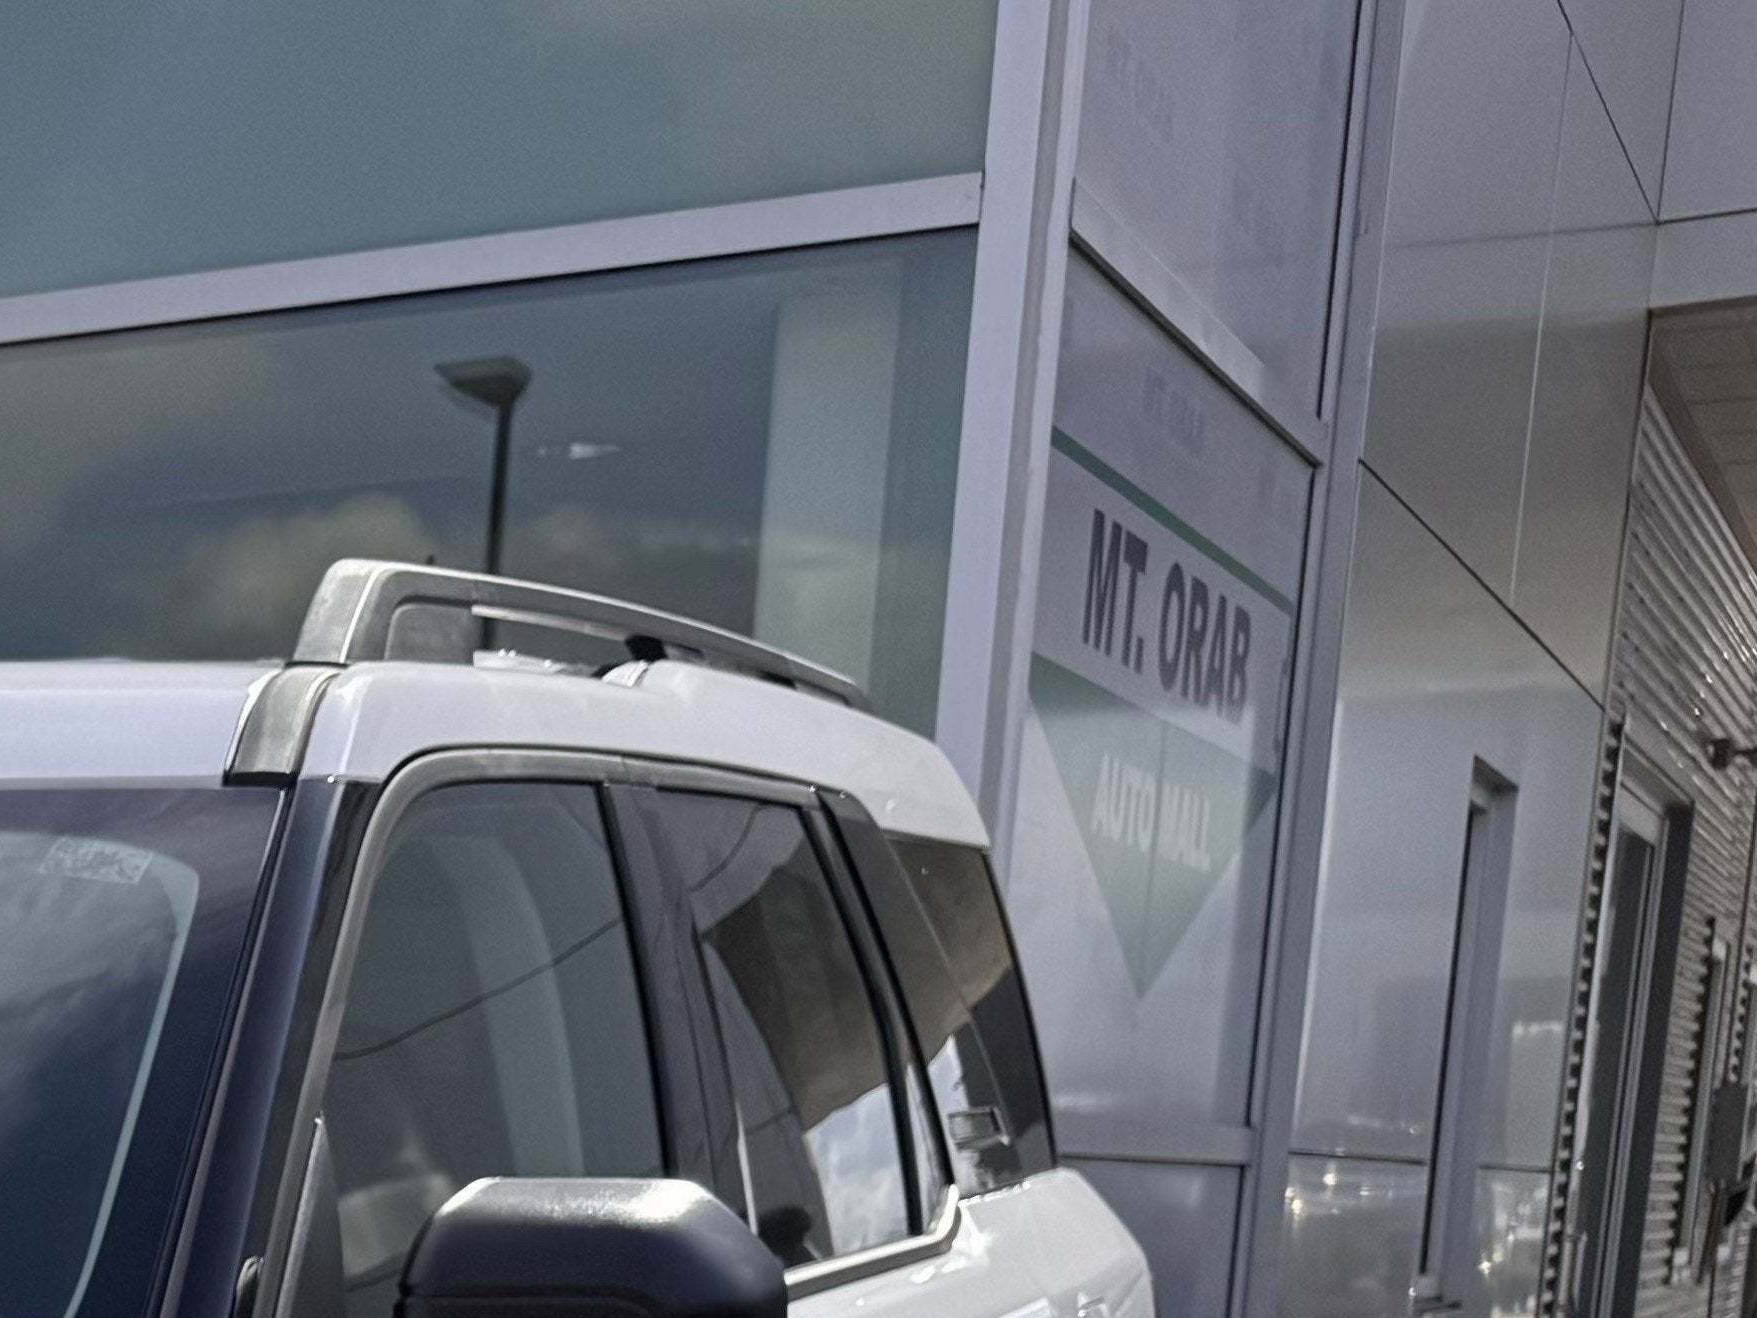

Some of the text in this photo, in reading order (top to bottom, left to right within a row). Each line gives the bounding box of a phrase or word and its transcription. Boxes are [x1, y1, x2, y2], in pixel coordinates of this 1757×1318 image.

[1082, 508, 1252, 724] MT. ORAB
[1090, 754, 1157, 853] AUTO
